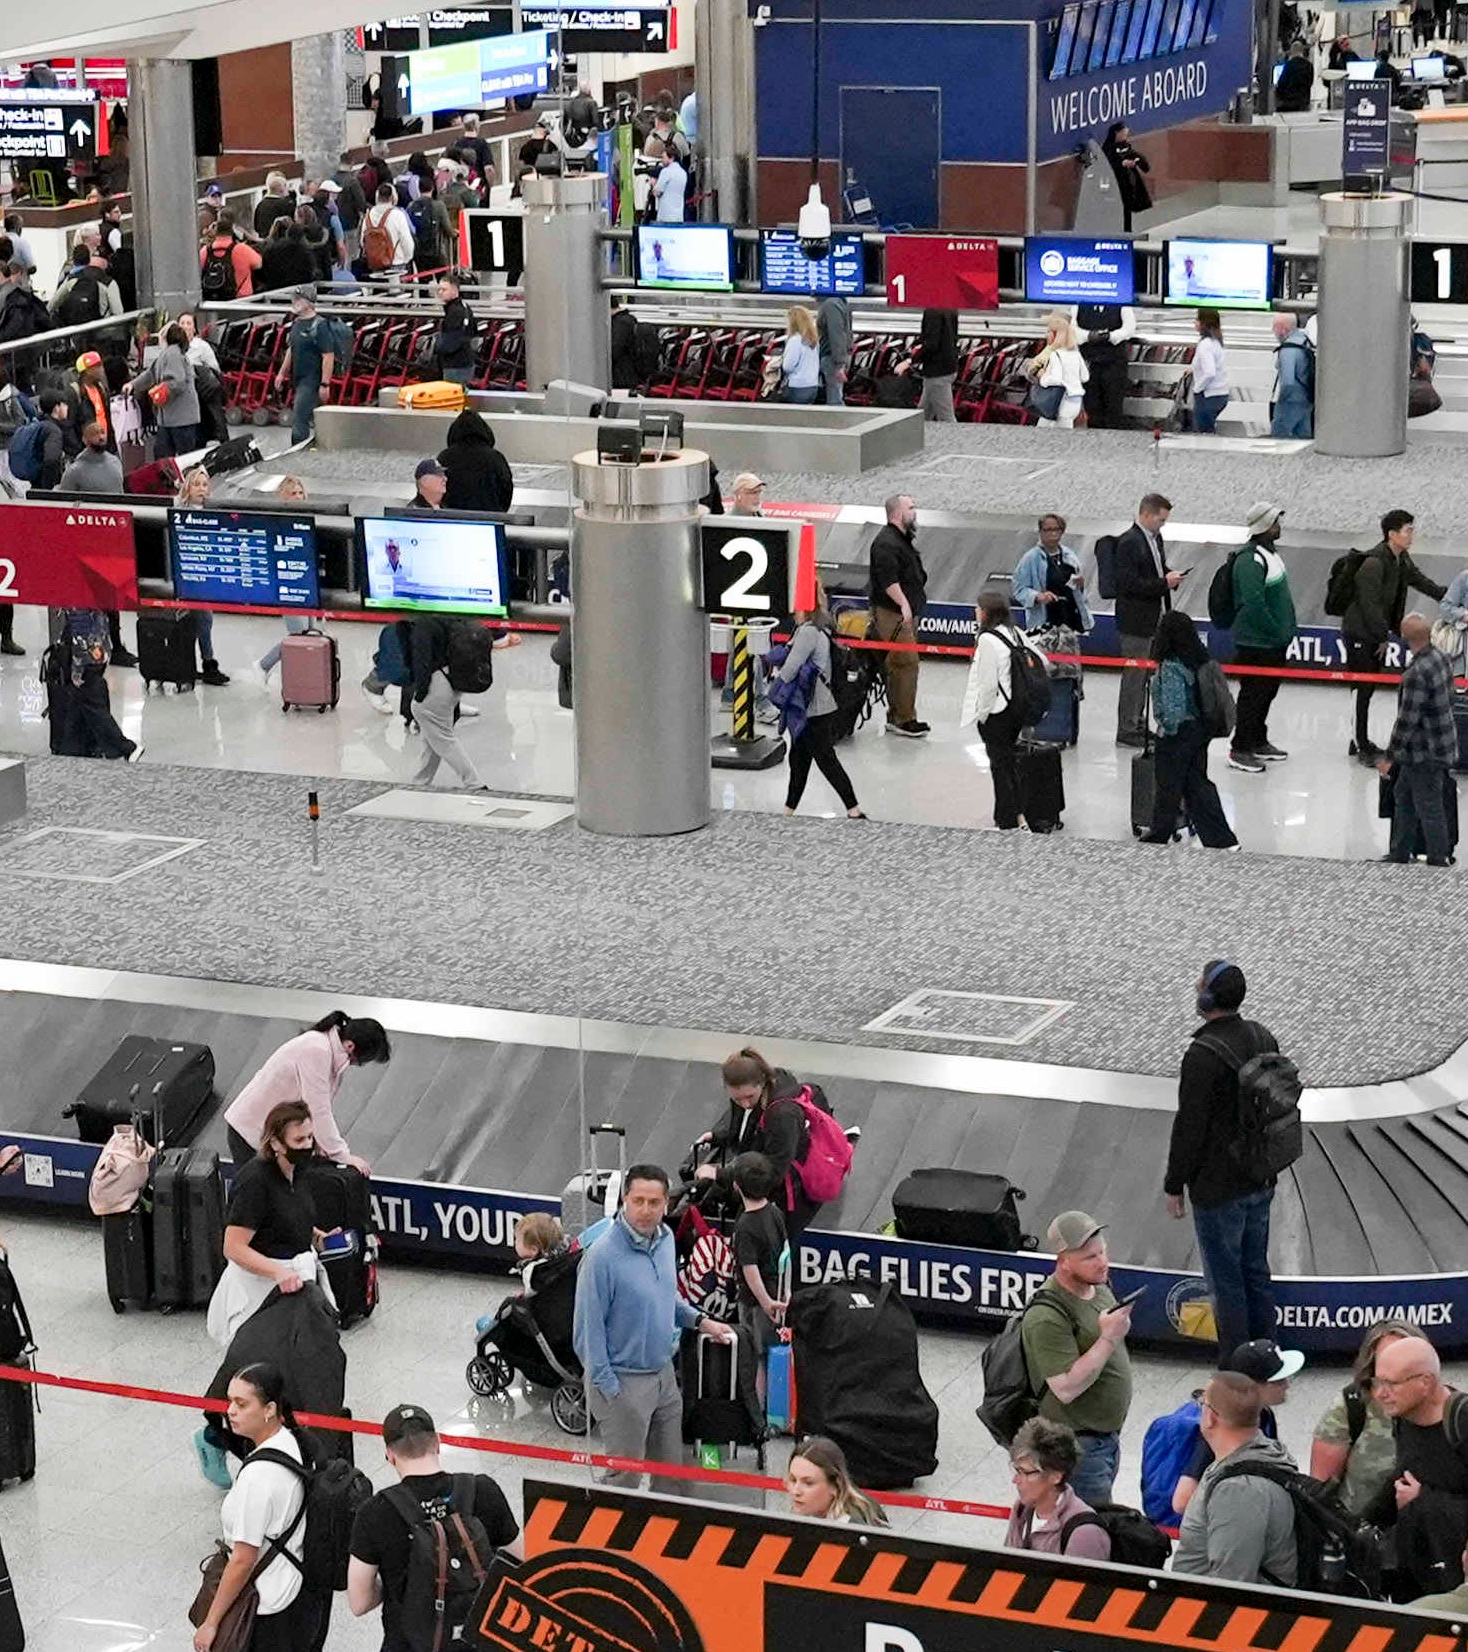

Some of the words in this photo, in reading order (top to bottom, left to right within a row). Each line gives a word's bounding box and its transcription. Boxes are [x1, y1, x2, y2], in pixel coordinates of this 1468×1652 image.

[1050, 77, 1137, 135] WELCOME
[1141, 61, 1207, 112] ABOARD
[487, 221, 509, 268] 1
[955, 242, 987, 251] DELTA
[890, 275, 907, 303] 1
[1431, 249, 1452, 301] 1
[77, 514, 117, 527] DELTA
[173, 512, 182, 524] 2
[719, 536, 771, 610] 2
[1284, 635, 1333, 667] ATL,
[369, 1193, 430, 1242] ATL,
[799, 1245, 872, 1285] BAG
[880, 1255, 973, 1304] FLIES
[979, 1266, 1051, 1309] FRE
[925, 1498, 947, 1510] ATL
